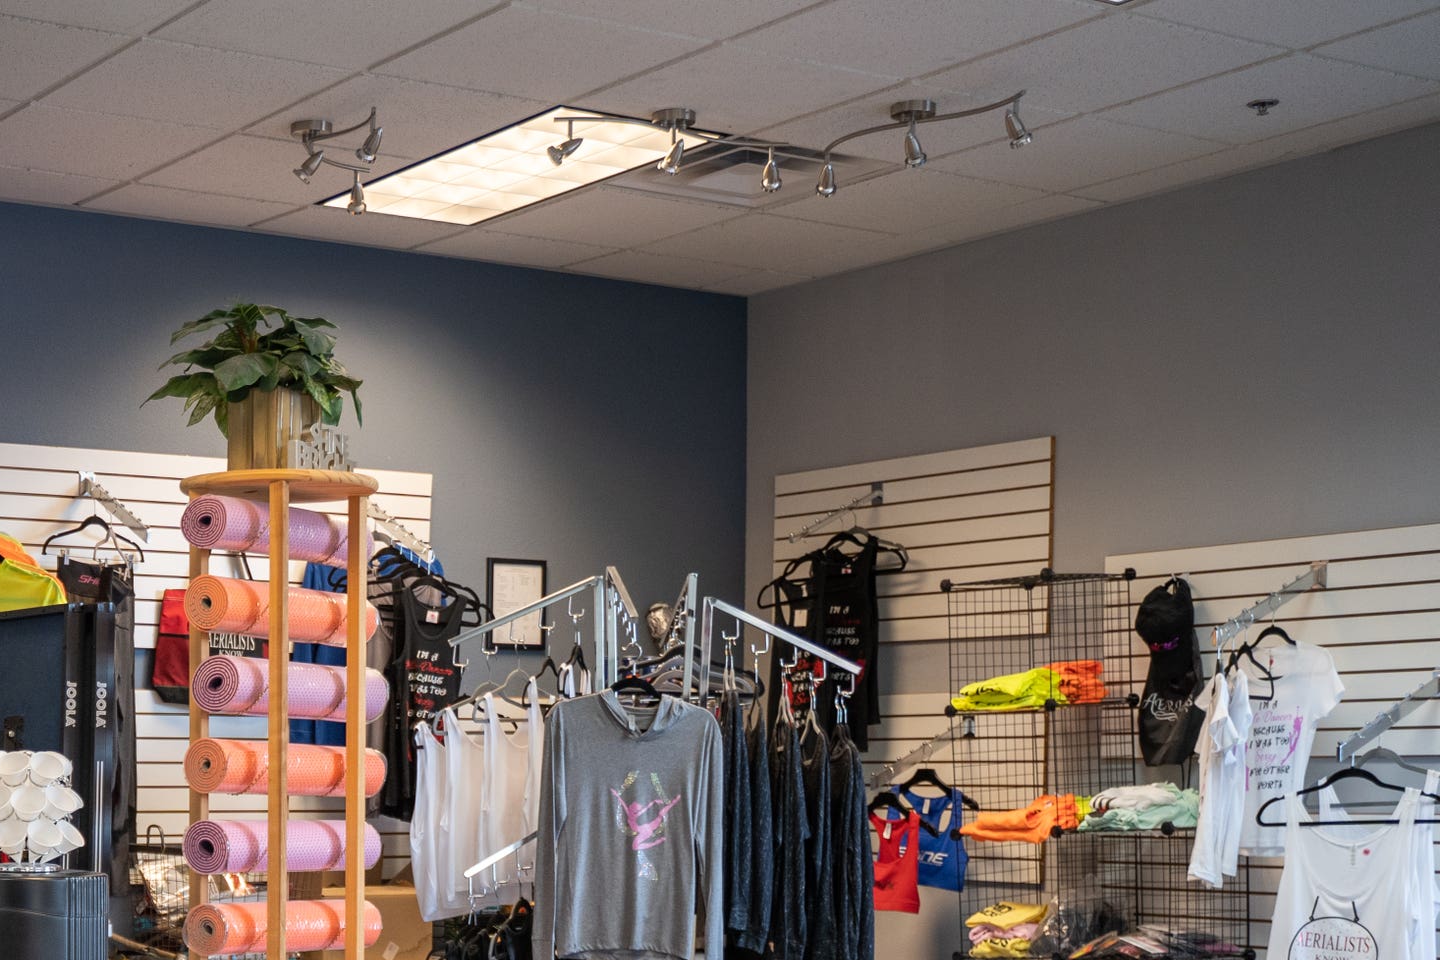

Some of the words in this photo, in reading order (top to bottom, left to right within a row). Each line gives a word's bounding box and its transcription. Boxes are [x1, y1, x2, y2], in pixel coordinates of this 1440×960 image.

[208, 632, 255, 651] AERIALISTS
[65, 680, 77, 728] JOOLA
[96, 681, 107, 728] JOOLA
[1297, 931, 1371, 954] AERIALISTS
